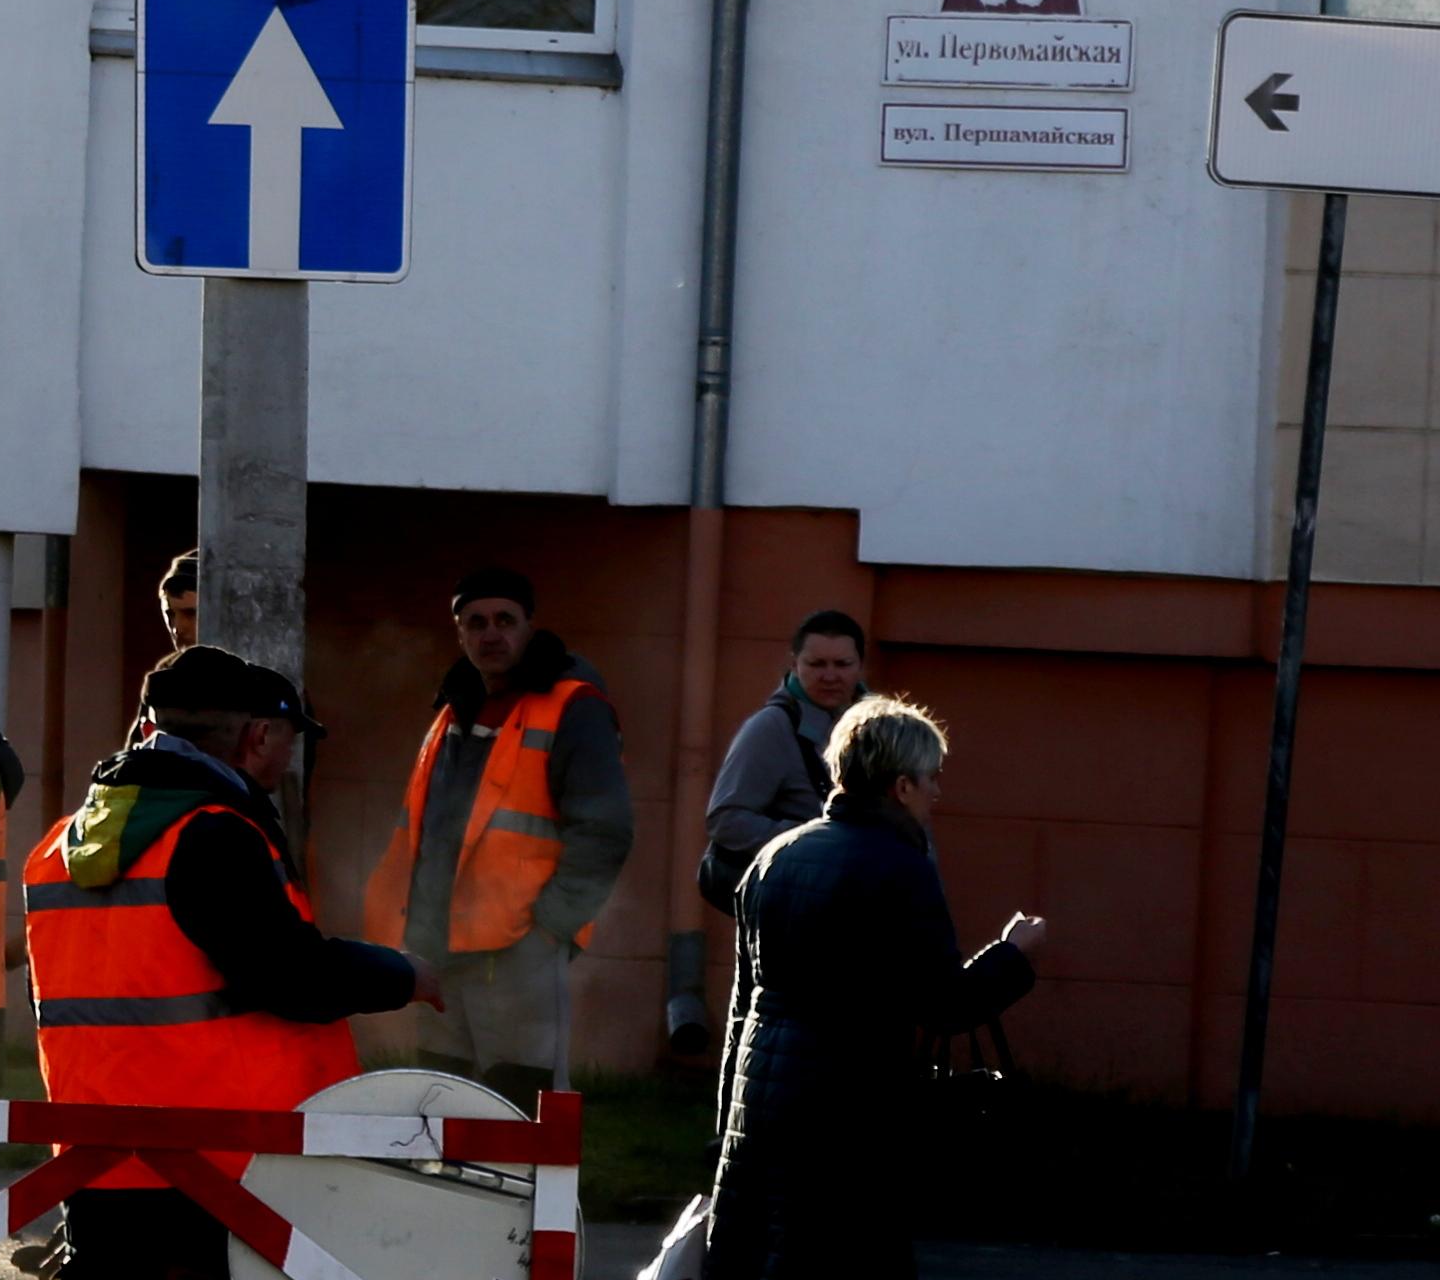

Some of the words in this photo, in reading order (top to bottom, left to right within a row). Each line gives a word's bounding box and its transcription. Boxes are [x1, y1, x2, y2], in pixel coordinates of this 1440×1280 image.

[896, 38, 930, 60] ул.
[938, 34, 1122, 66] Первомайская
[893, 125, 935, 145] вул.
[943, 122, 1116, 147] Першамайская
